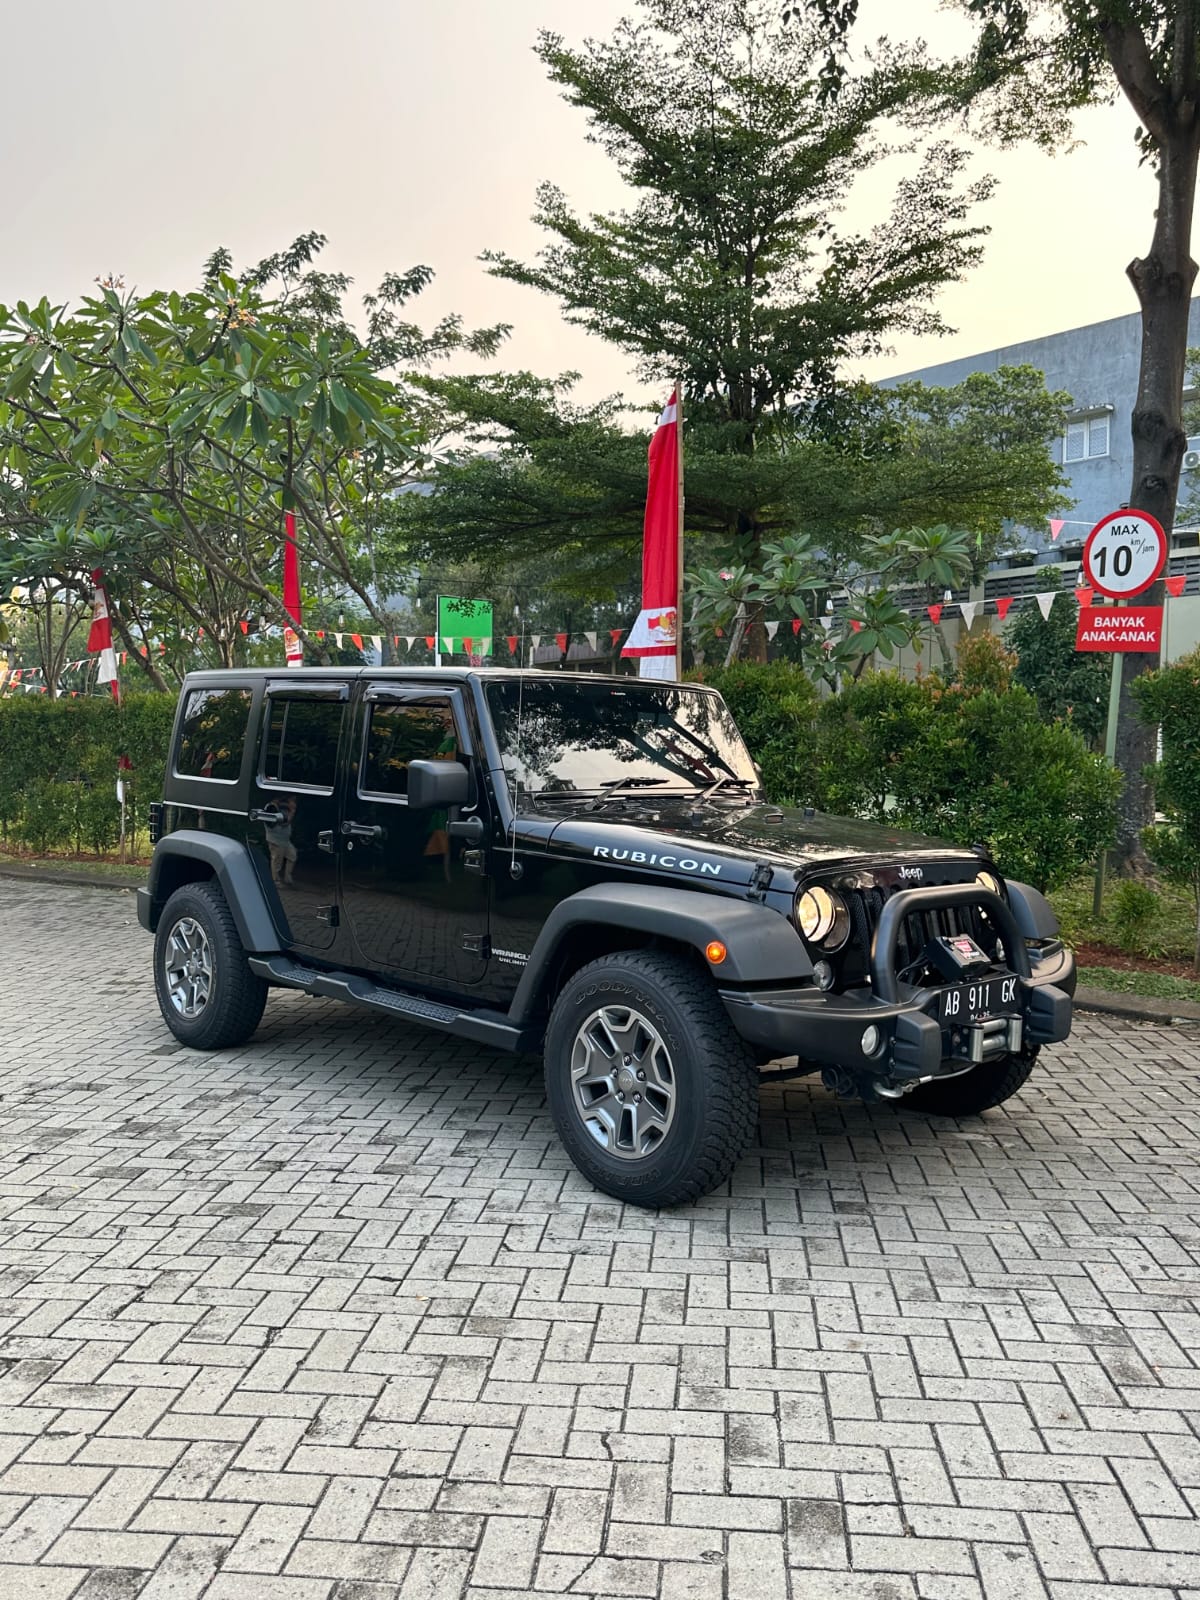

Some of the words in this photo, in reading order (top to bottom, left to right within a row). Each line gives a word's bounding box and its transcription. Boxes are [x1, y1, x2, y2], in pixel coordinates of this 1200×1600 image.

[1111, 524, 1139, 536] MAX
[1093, 545, 1132, 577] 10
[1130, 538, 1155, 554] km/jam
[1094, 616, 1145, 628] BANYAK
[1081, 631, 1156, 642] ANAK-ANAK
[593, 846, 722, 875] RUBICON
[898, 866, 923, 880] Jeep
[491, 948, 530, 961] WRANGL
[944, 991, 960, 1016] AB
[968, 984, 989, 1010] 911
[1001, 978, 1016, 1002] GK
